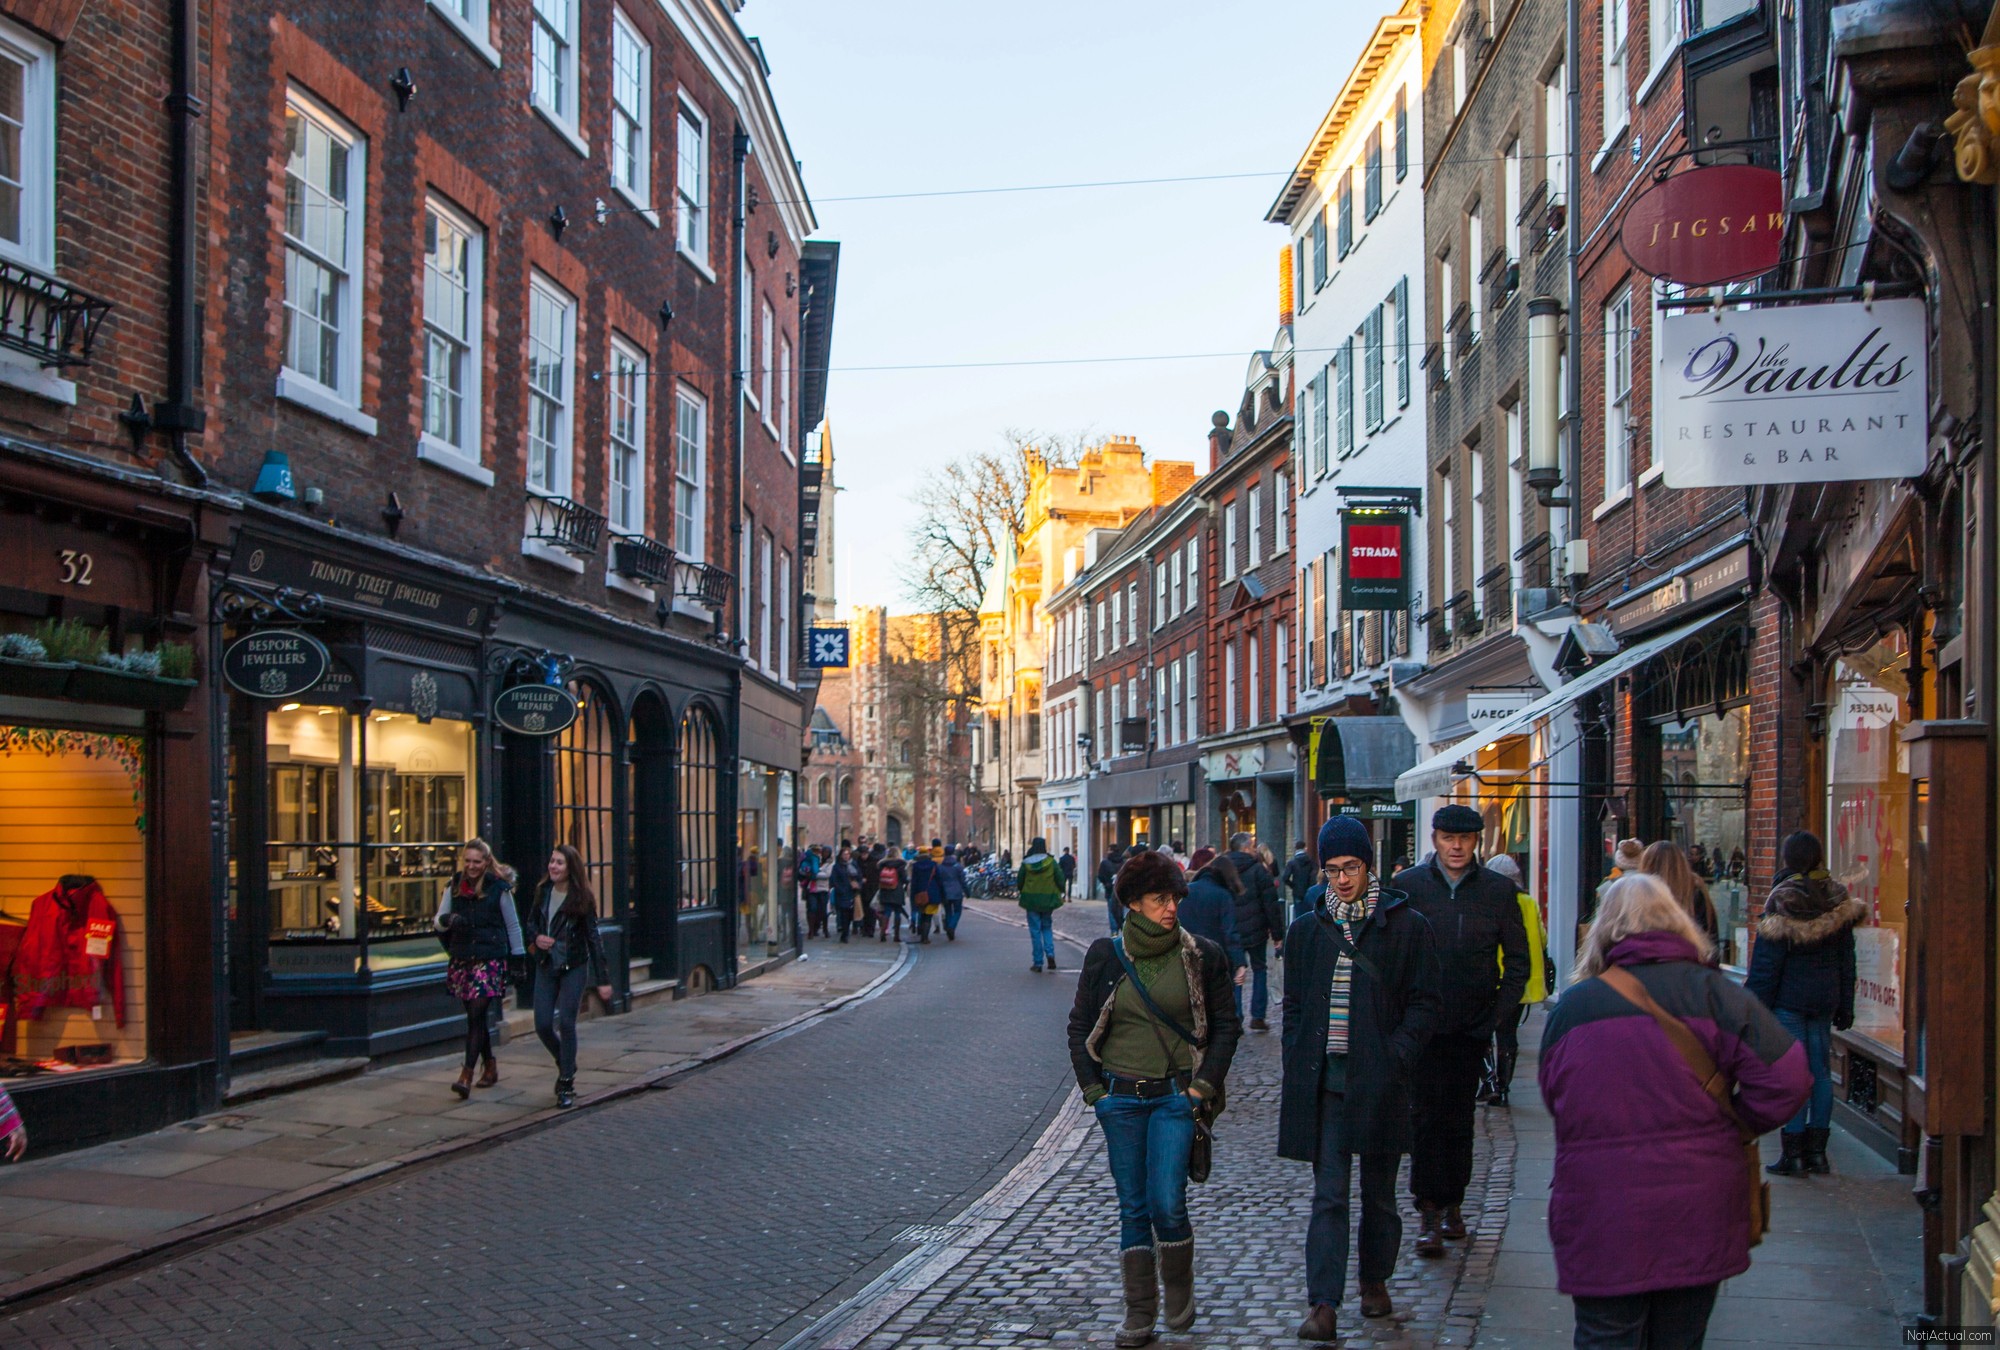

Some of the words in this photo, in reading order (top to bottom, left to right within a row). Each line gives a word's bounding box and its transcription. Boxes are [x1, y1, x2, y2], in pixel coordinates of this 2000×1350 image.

[1679, 326, 1914, 400] Vaults
[1760, 343, 1789, 368] the
[1678, 414, 1908, 441] RESTAURANT
[1743, 453, 1757, 465] &
[1777, 447, 1839, 464] BAR
[1351, 547, 1398, 557] STRADA
[60, 549, 93, 585] 32
[309, 560, 356, 586] TRINITY
[355, 573, 393, 596] STREET
[393, 583, 442, 609] JEWELLERS
[1693, 574, 1713, 592] TAKE
[1717, 561, 1740, 579] AWAY
[248, 639, 299, 652] BESPOKE
[241, 652, 307, 668] JEWELLERS
[511, 692, 560, 702] JEWELLERY
[517, 701, 554, 712] REPAIRS
[1471, 708, 1519, 720] JAEGE
[1372, 803, 1402, 812] STRADA
[89, 922, 112, 933] SALE
[1860, 978, 1869, 998] TO
[1883, 985, 1896, 1008] OFF
